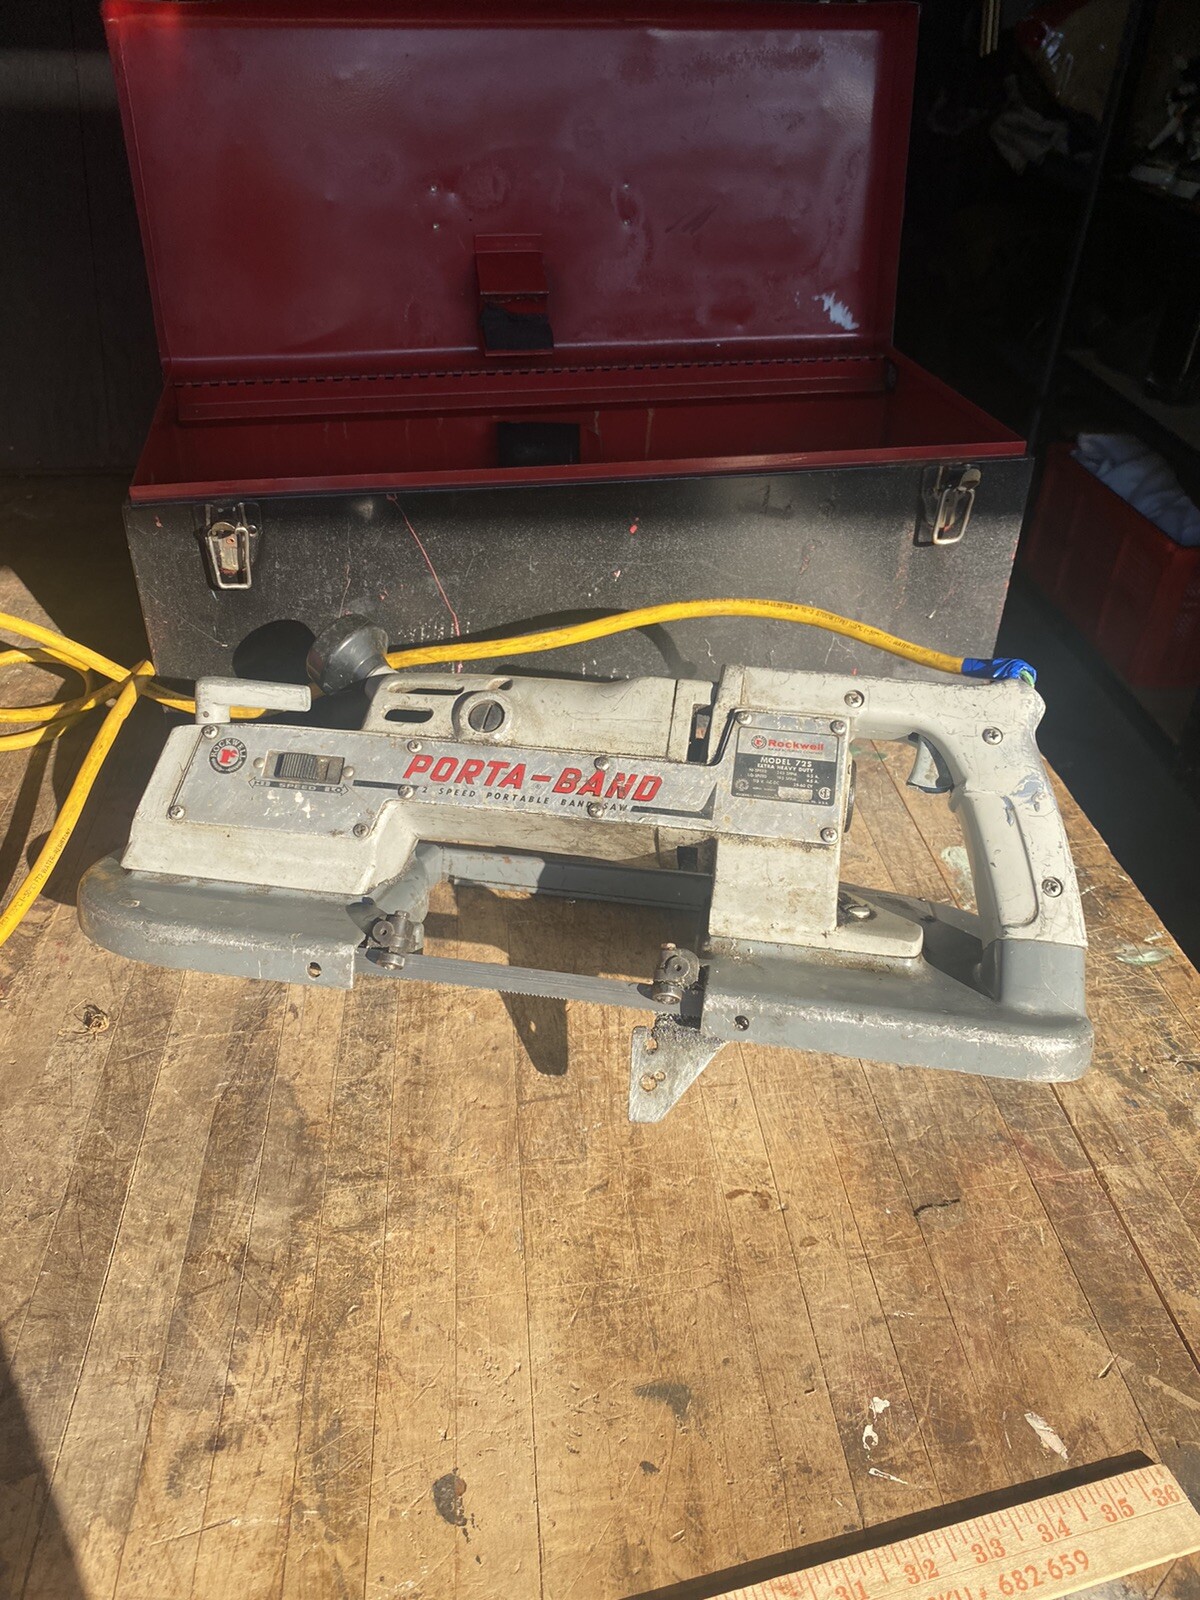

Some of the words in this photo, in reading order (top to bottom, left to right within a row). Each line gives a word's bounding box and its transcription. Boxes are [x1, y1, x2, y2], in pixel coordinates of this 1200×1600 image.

[768, 739, 825, 751] Rockwell
[760, 756, 791, 766] MODEL
[777, 765, 797, 773] HEAVY
[279, 782, 317, 791] SPEED
[421, 786, 428, 794] 2
[438, 787, 476, 798] SPEED
[486, 791, 550, 805] PORTABLE
[602, 801, 628, 812] SAW
[904, 1558, 940, 1585] 32
[971, 1538, 1007, 1563] 33
[1037, 1516, 1072, 1543] 34
[1100, 1497, 1135, 1522] 35
[1151, 1484, 1181, 1508] 36
[998, 1550, 1089, 1596] 682-659
